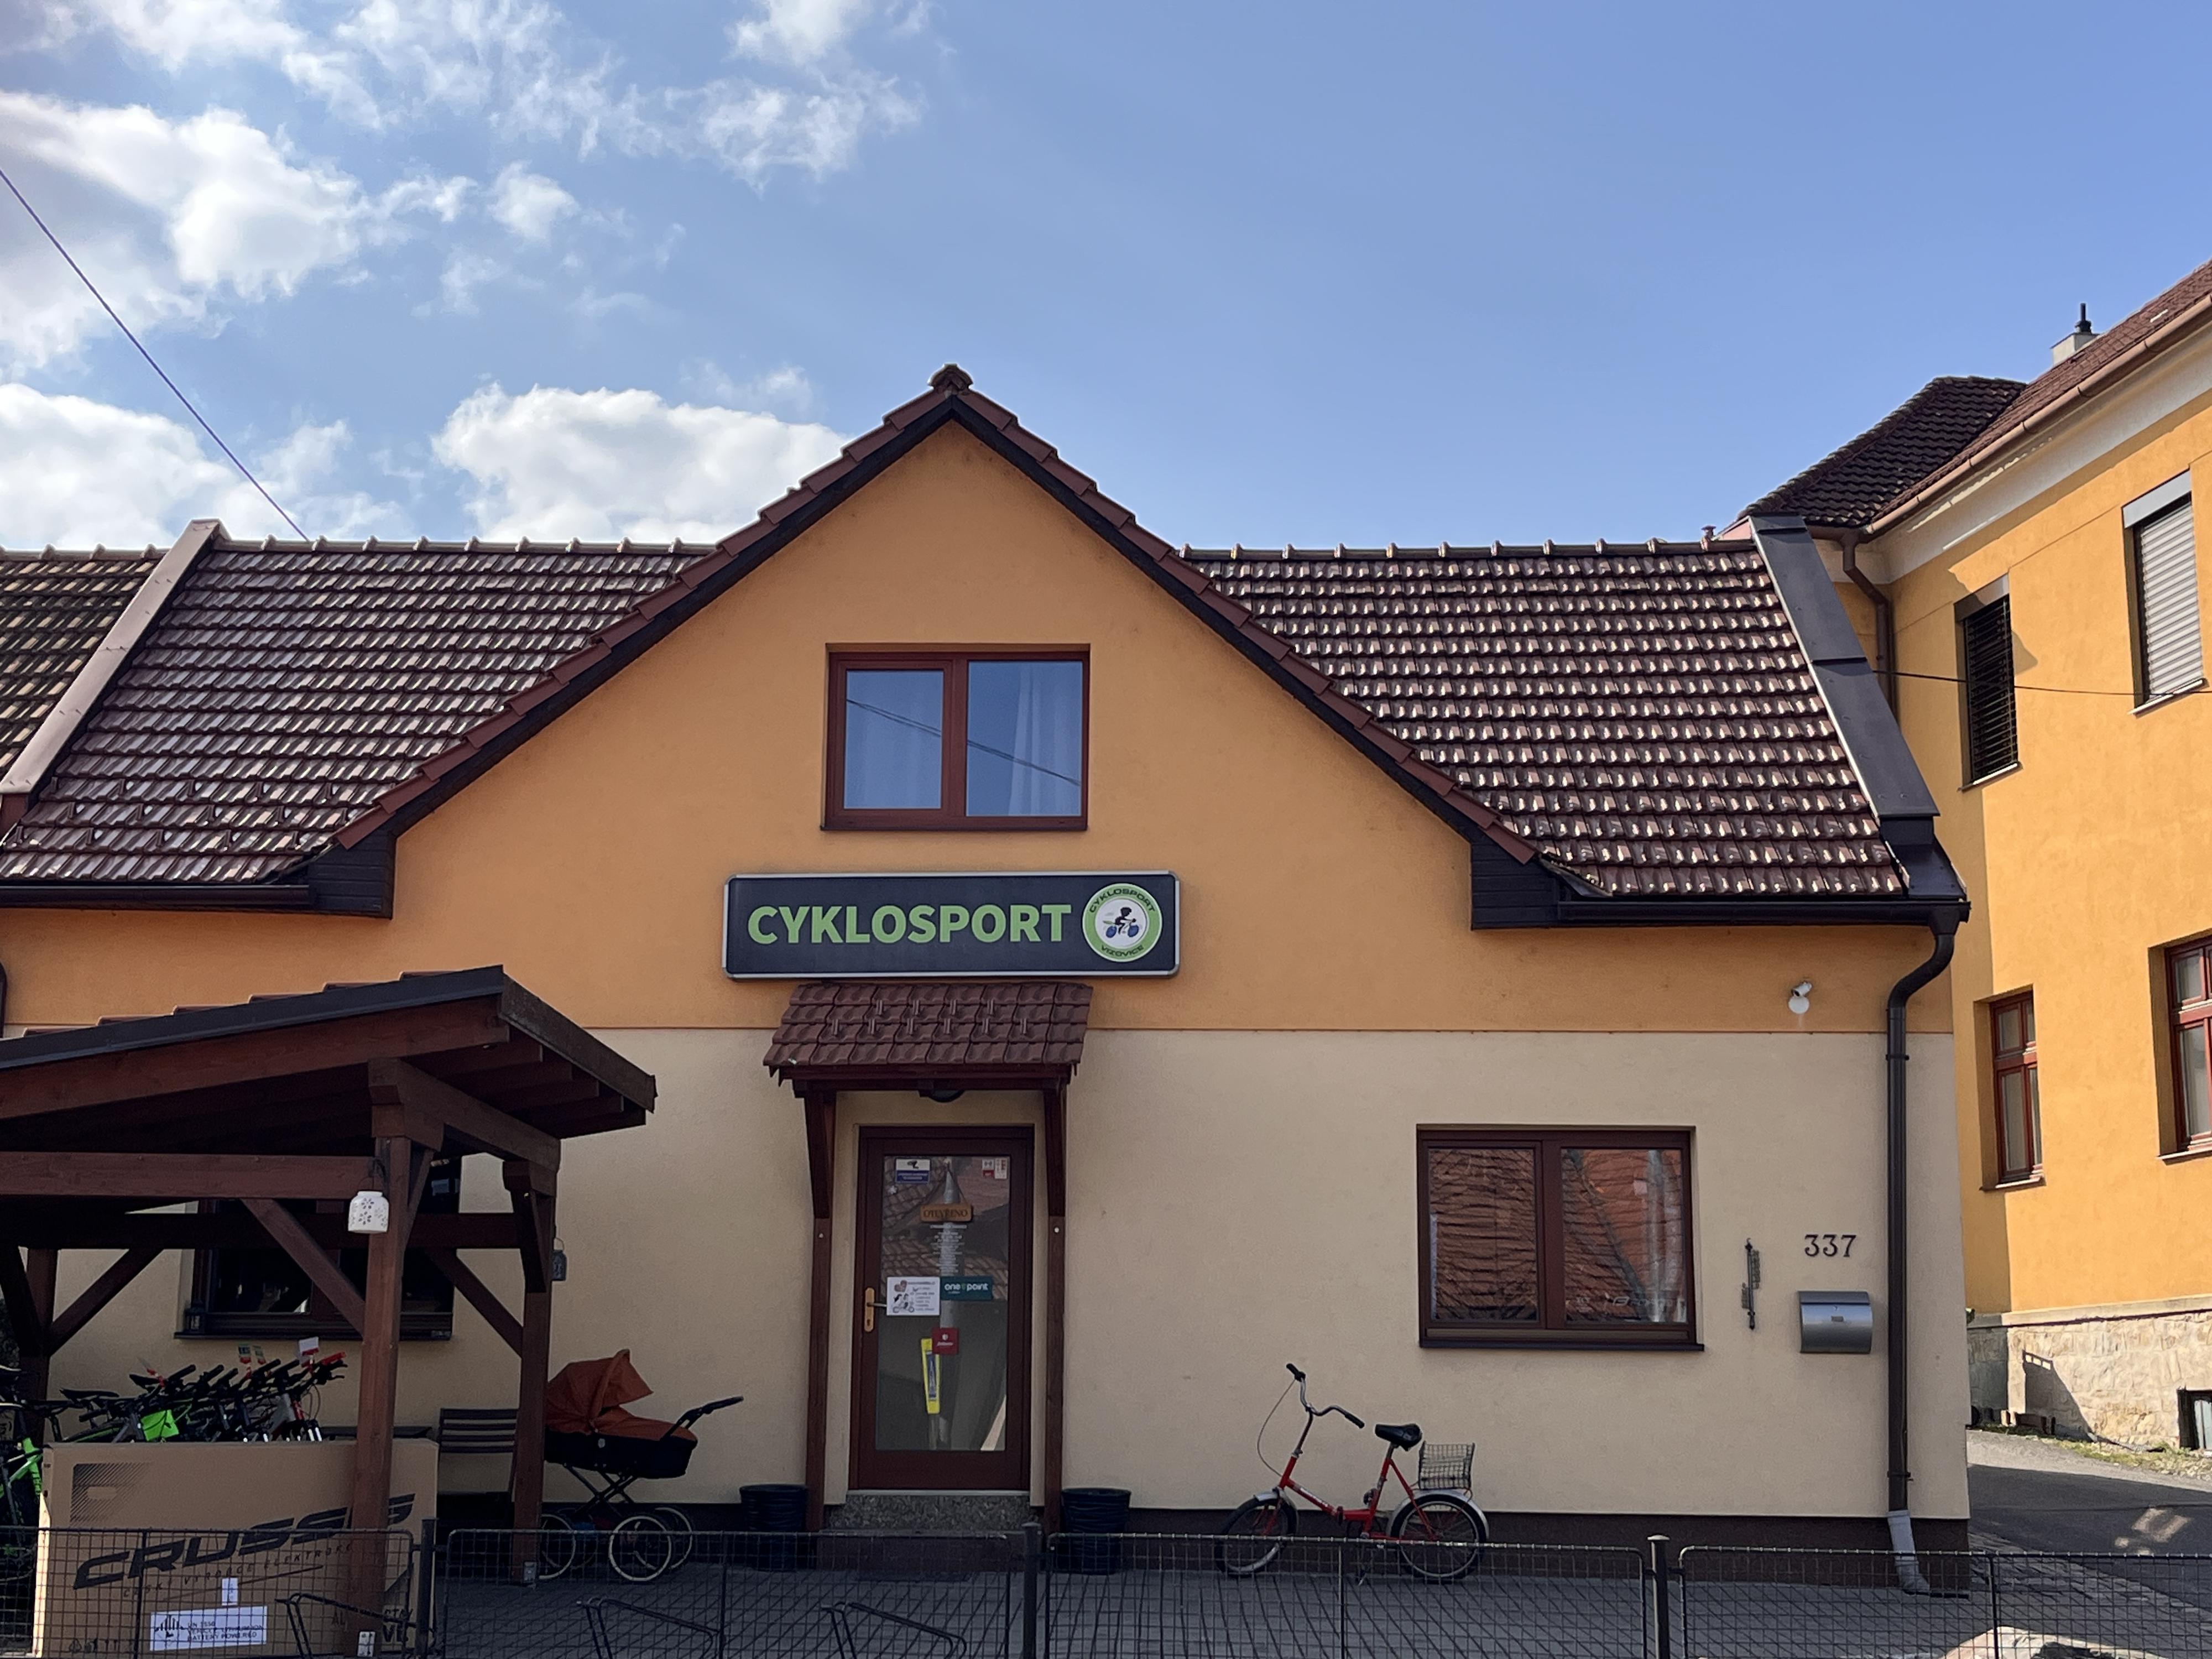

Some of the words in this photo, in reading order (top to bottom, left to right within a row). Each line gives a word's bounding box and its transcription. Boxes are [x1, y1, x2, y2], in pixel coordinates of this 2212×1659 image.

[1089, 889, 1155, 912] CYKLOSPORT
[748, 904, 1071, 944] CYKLOSPORT
[1102, 945, 1144, 957] VIZOVICE
[1804, 1234, 1856, 1257] 337
[72, 1494, 415, 1590] CRUSSS
